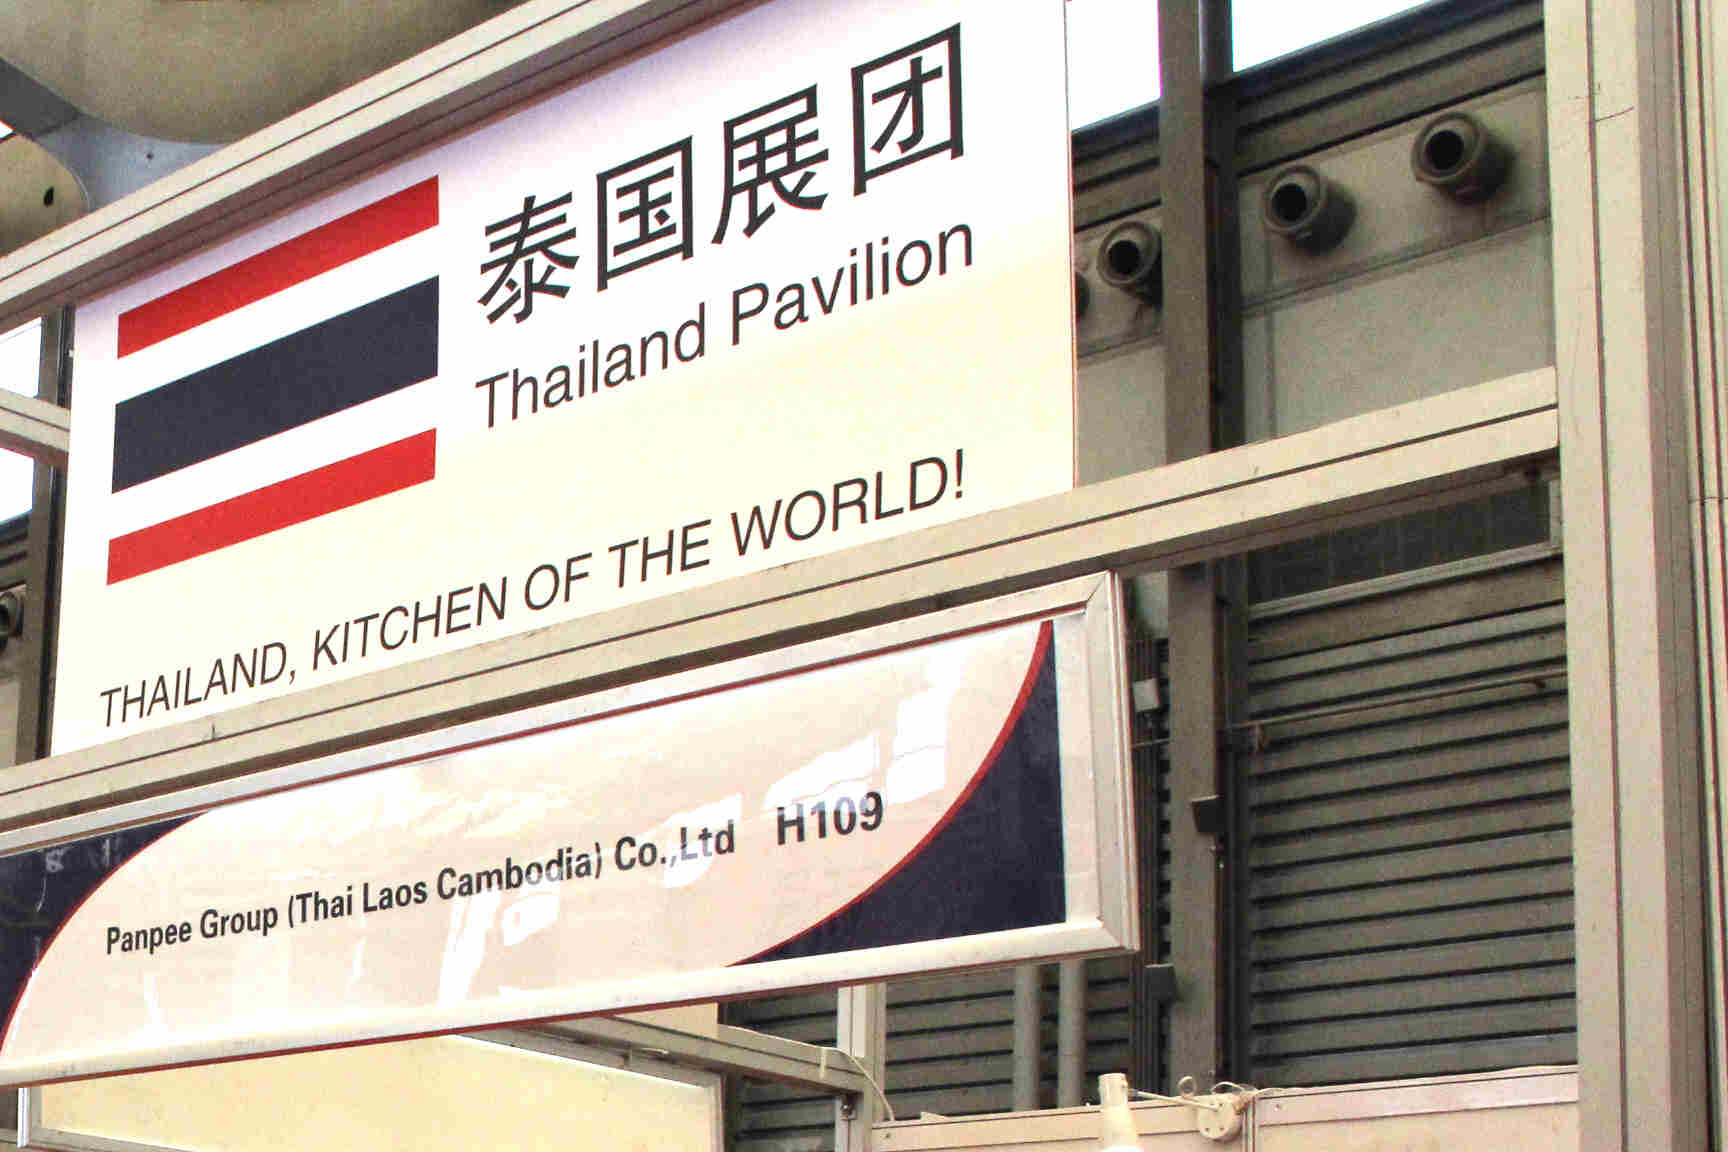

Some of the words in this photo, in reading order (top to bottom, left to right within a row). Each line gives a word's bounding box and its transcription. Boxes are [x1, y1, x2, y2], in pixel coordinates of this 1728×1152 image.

[477, 23, 966, 326] 泰国展团
[475, 301, 707, 428] Thailand
[731, 222, 974, 348] Pavilion
[100, 643, 296, 729] THAILAND,
[312, 577, 508, 670] KITCHEN
[524, 554, 592, 612] OF
[608, 520, 712, 588] THE
[730, 449, 966, 557] WORLD!
[106, 922, 192, 955] Panpee
[199, 902, 279, 938] Group
[287, 885, 354, 928] (Thai
[363, 880, 428, 913] Laos
[437, 842, 602, 900] Cambodia)
[614, 819, 736, 872] Co.,Ltd
[776, 791, 884, 846] H109
